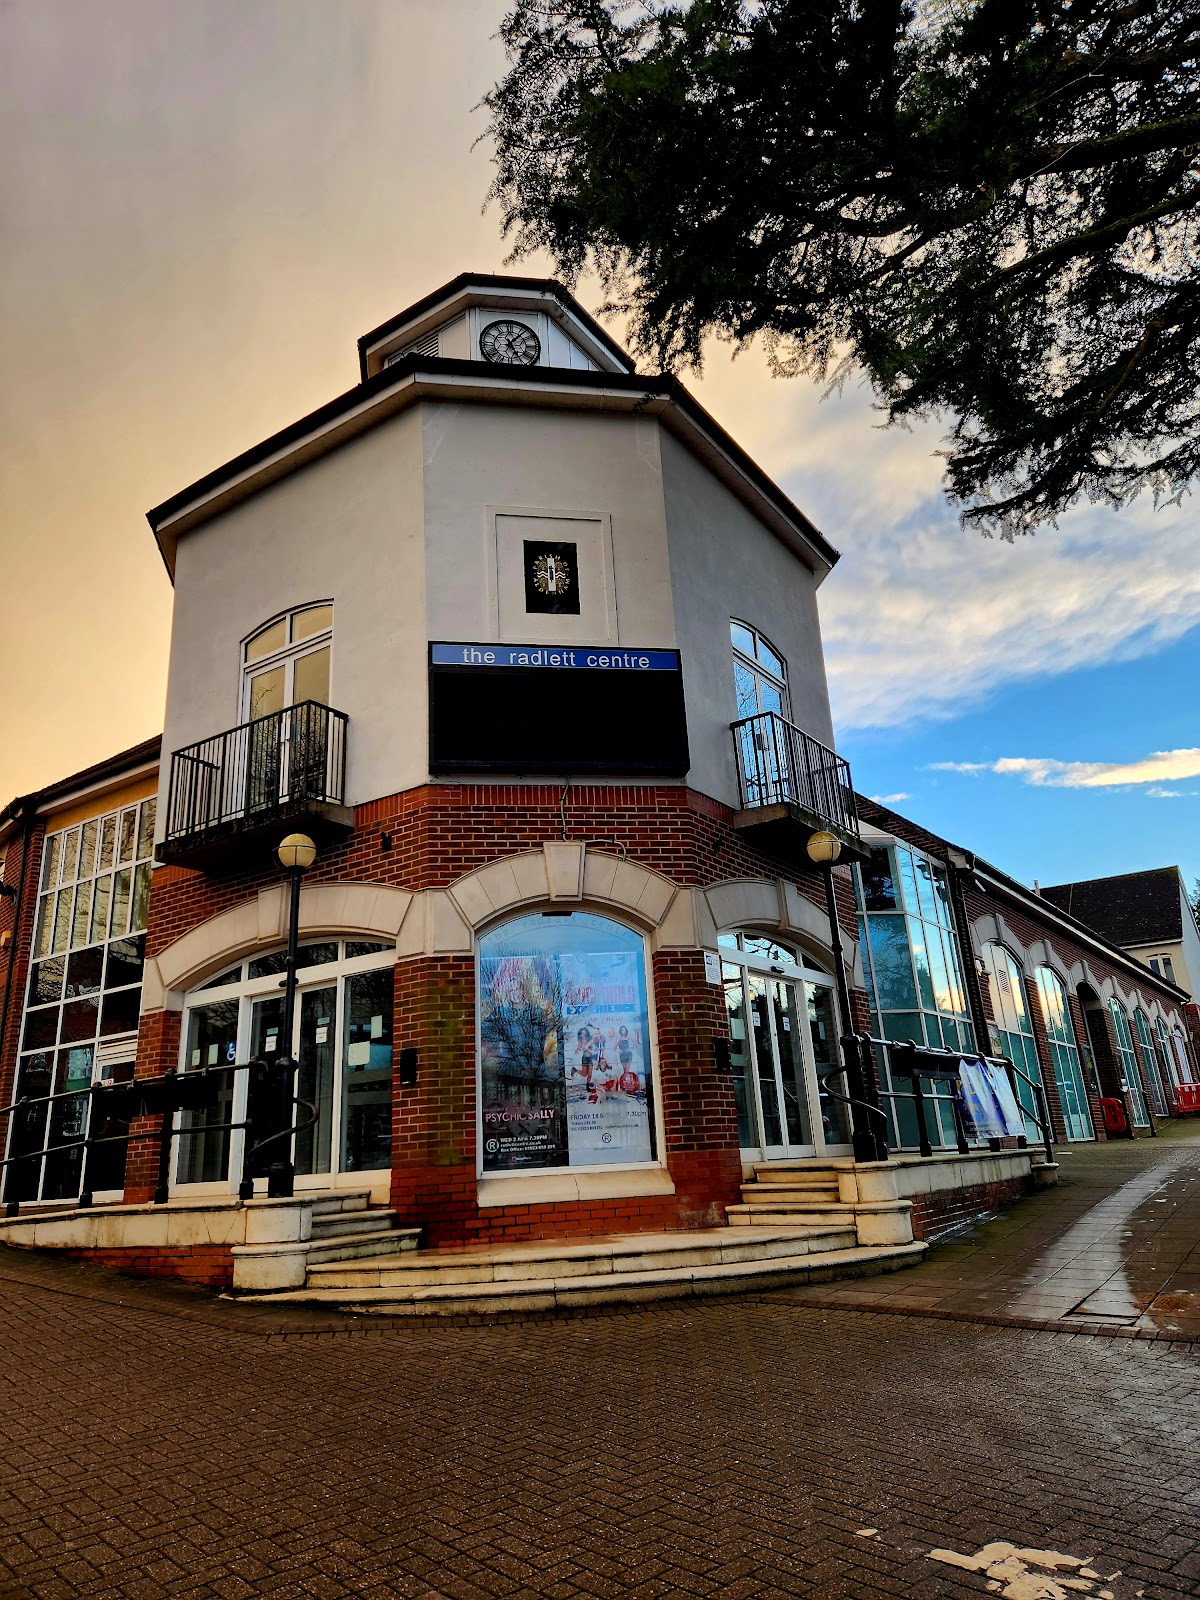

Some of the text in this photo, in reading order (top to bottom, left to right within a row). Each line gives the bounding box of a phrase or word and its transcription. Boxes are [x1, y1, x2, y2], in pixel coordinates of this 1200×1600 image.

[462, 648, 650, 669] the radlett centre
[488, 929, 509, 943] the
[591, 918, 635, 941] centre
[485, 1109, 555, 1123] PSYCHIC SALLY
